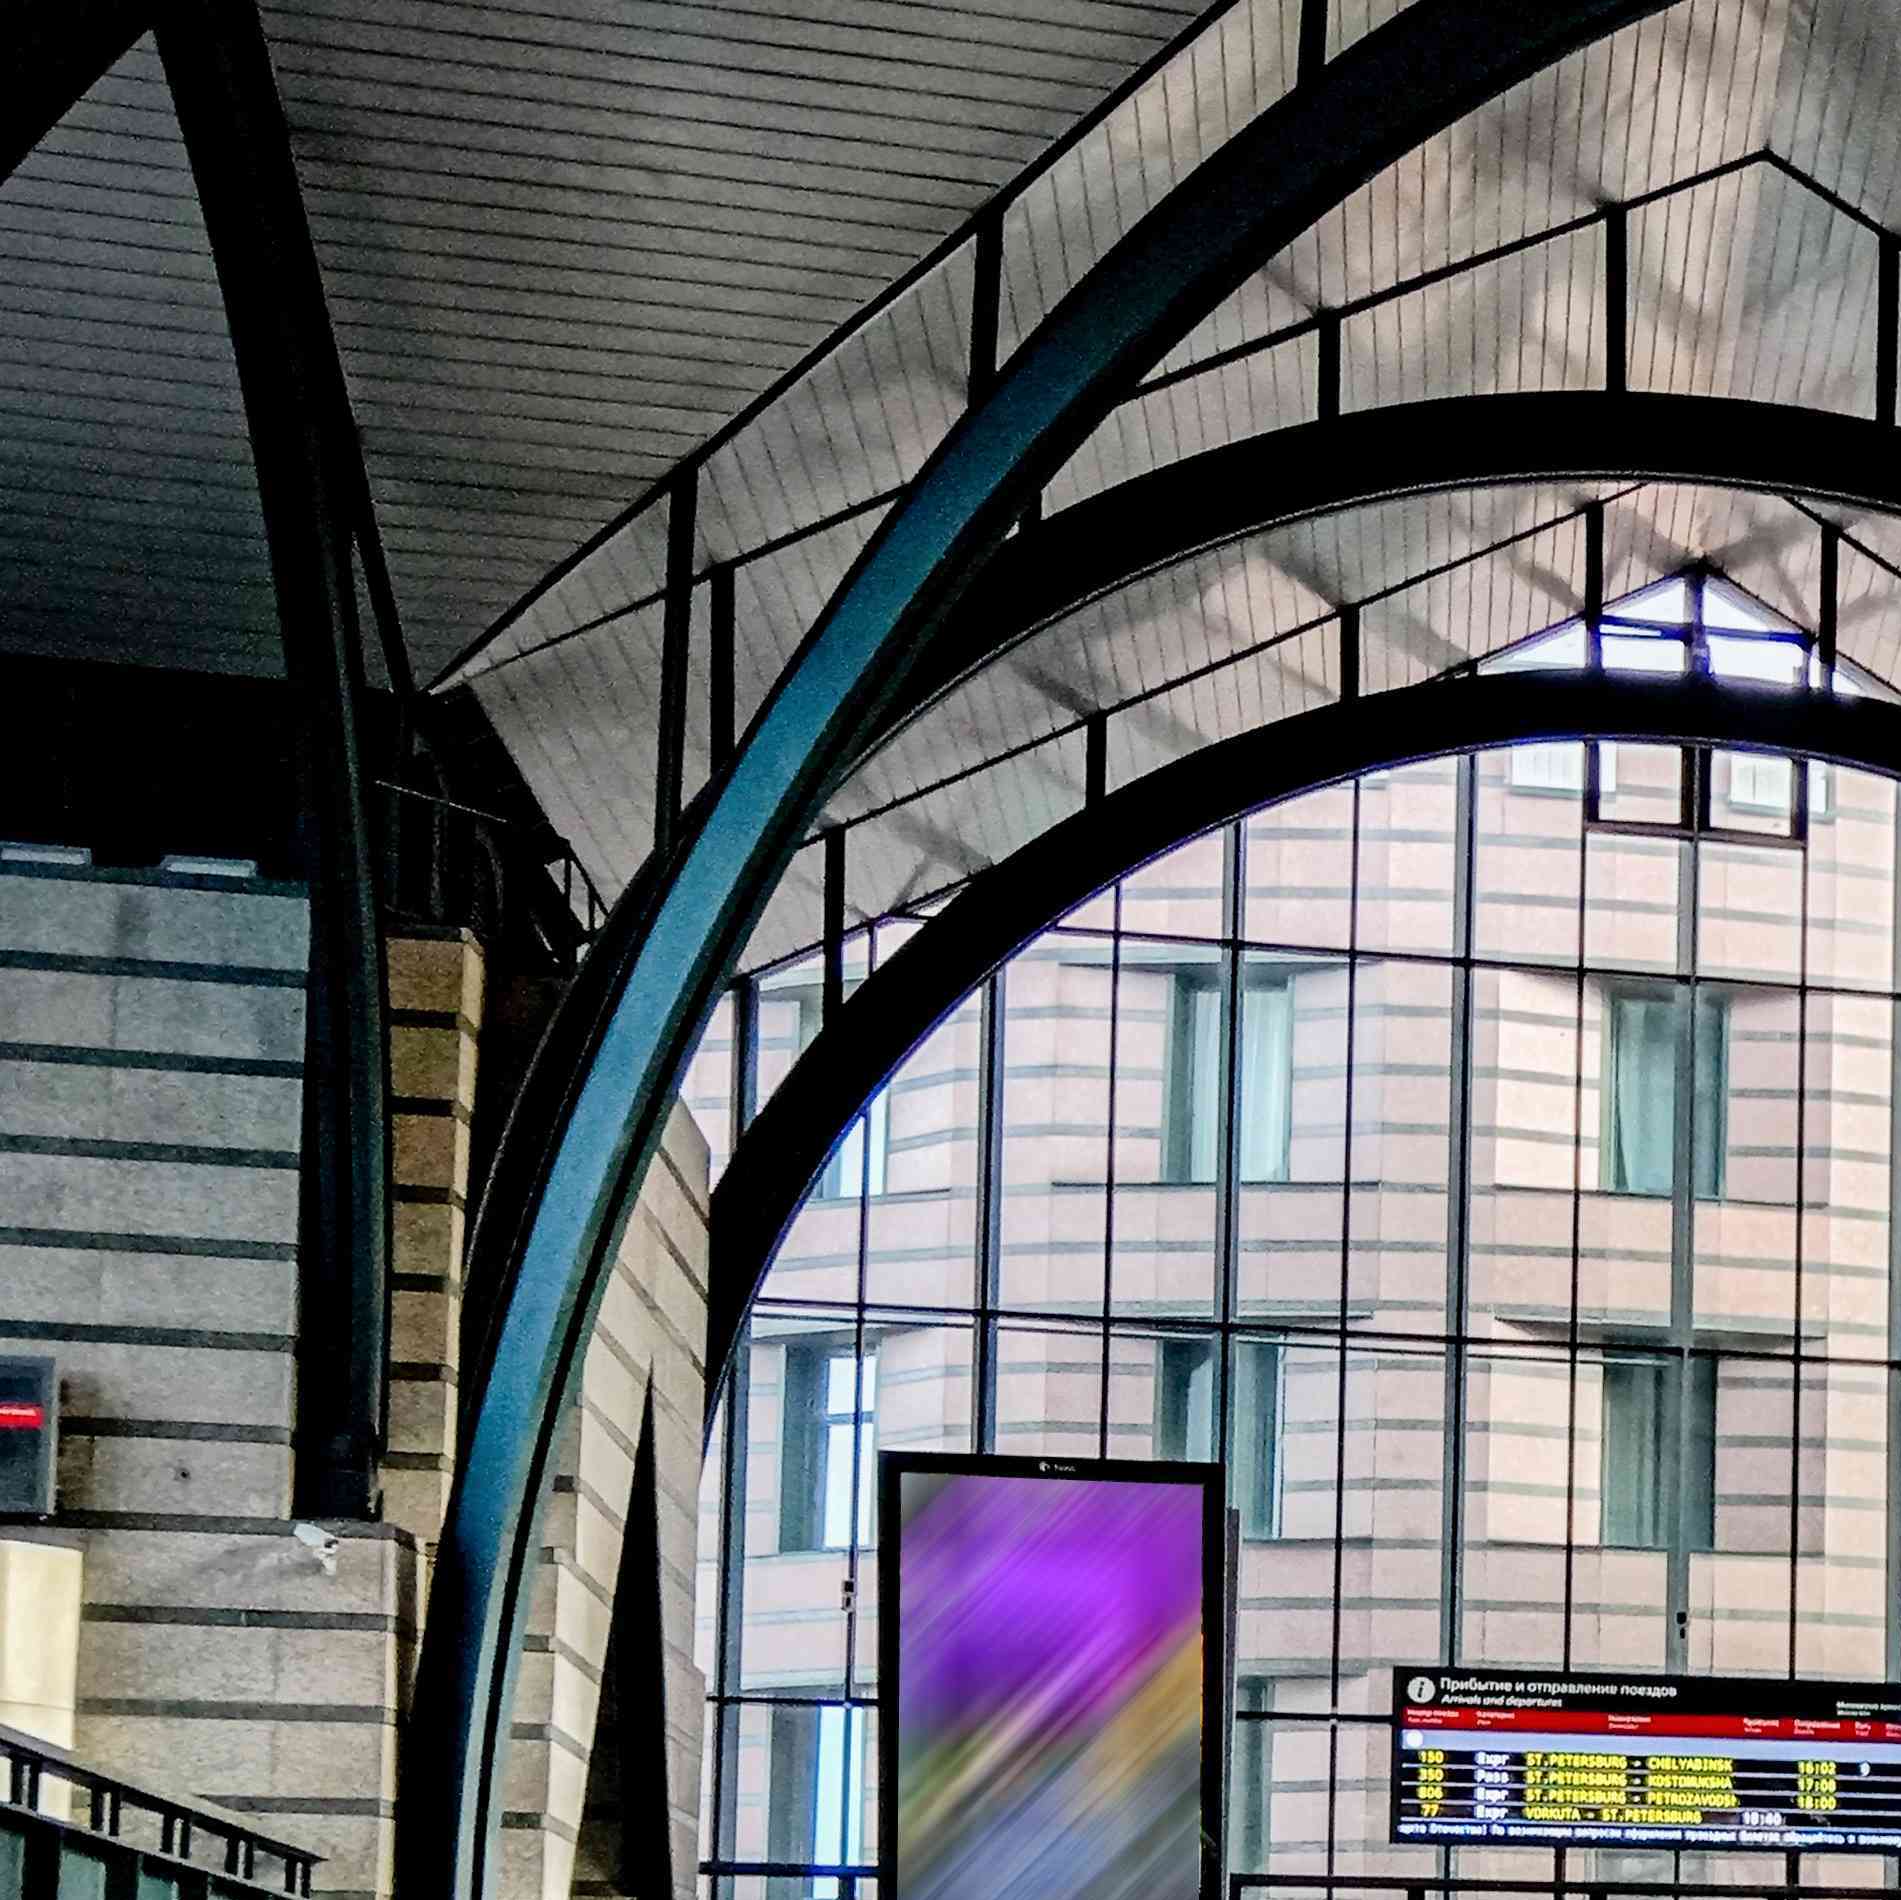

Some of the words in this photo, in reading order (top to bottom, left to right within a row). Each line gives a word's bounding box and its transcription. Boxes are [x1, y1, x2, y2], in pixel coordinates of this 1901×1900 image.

[1441, 1677, 1512, 1692] Прибытие
[1515, 1681, 1525, 1692] и
[1527, 1682, 1618, 1695] отправление
[1620, 1685, 1677, 1698] поездов
